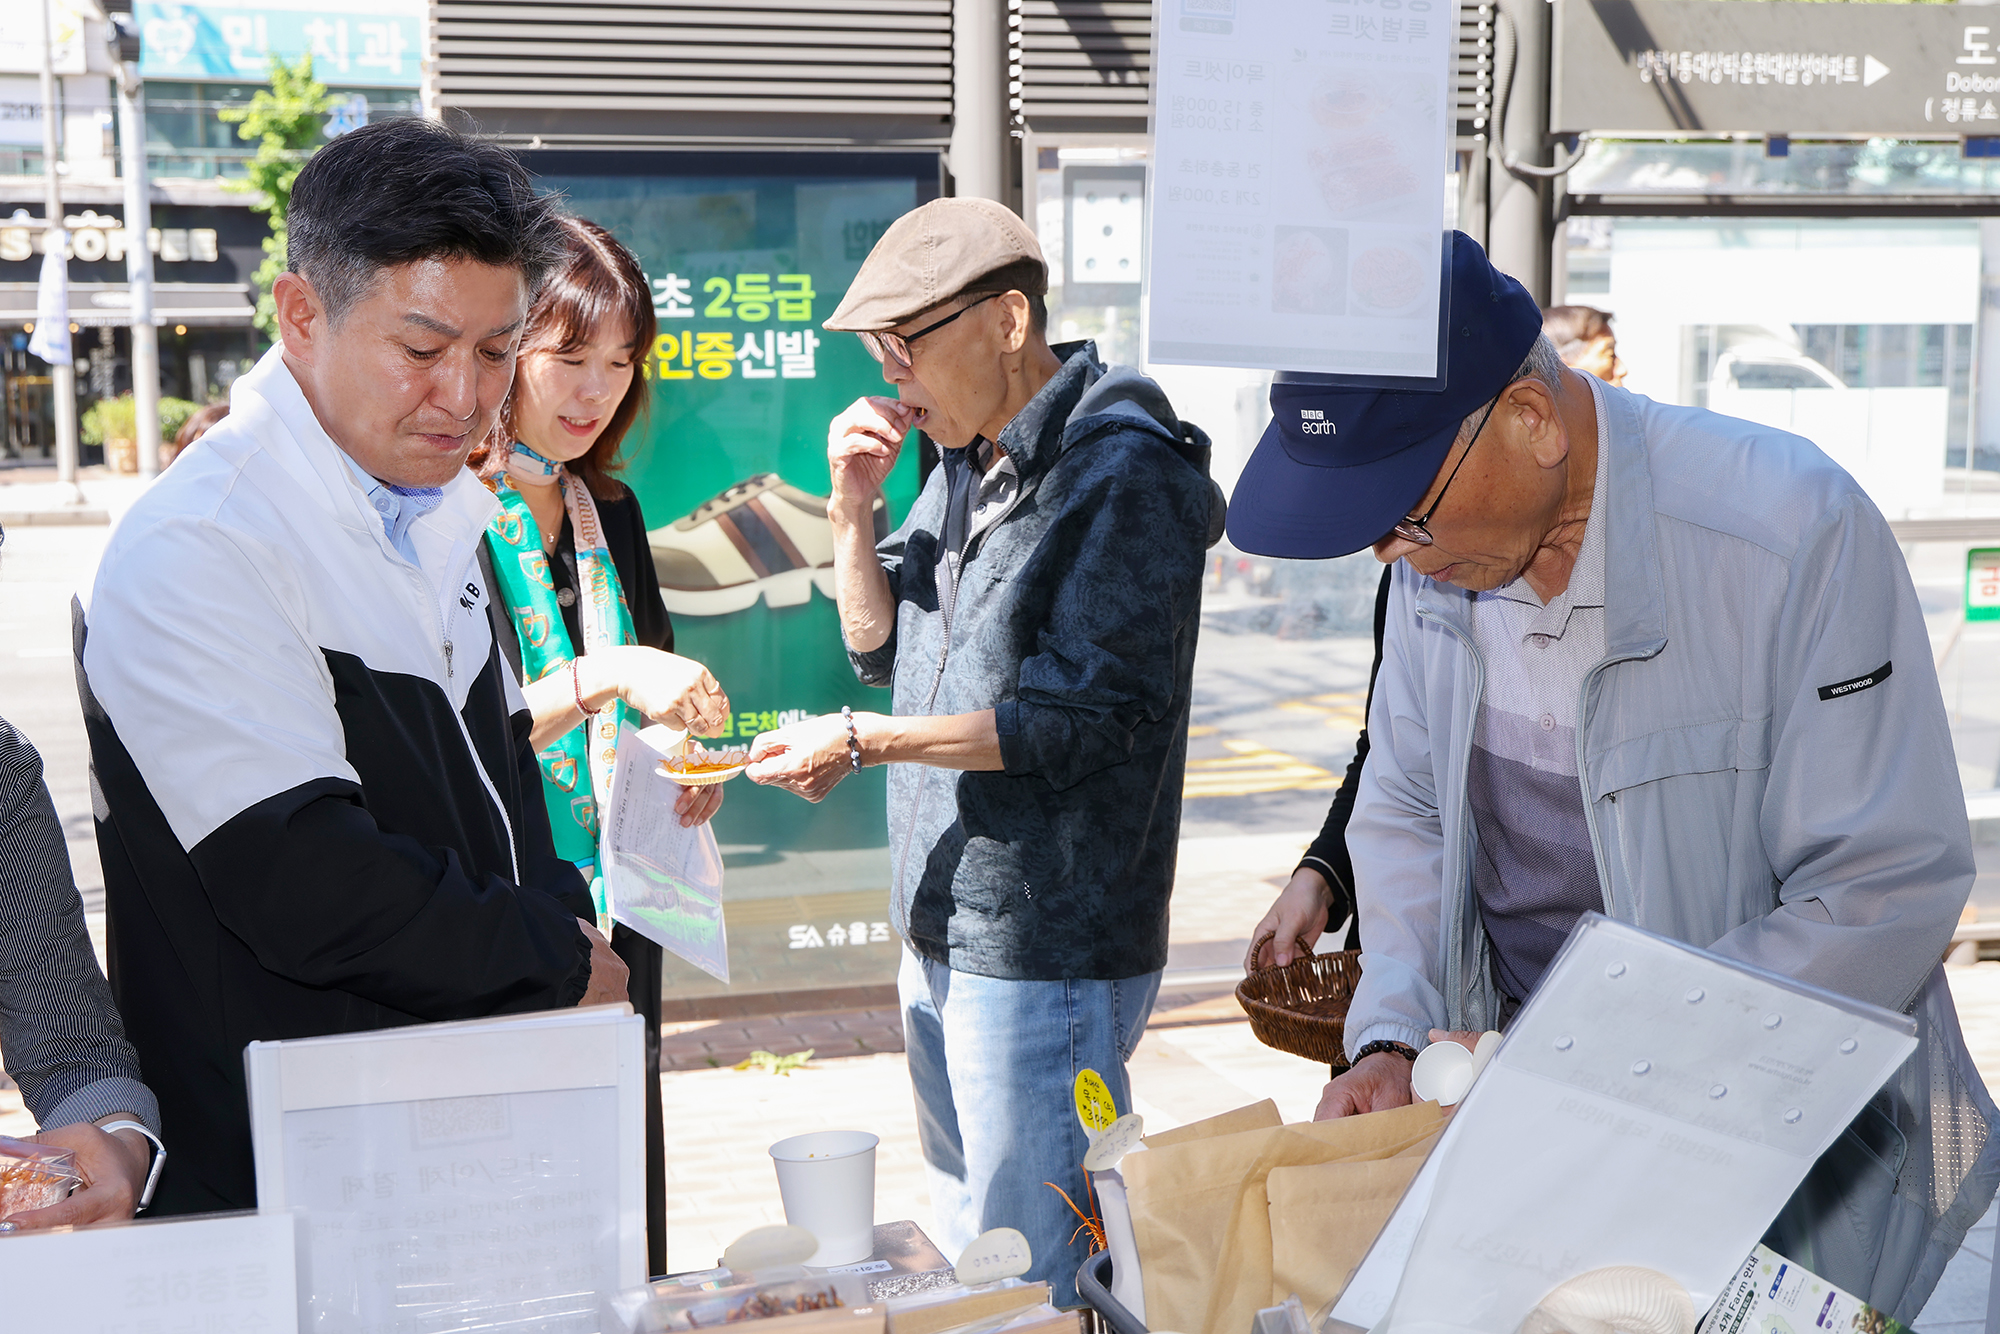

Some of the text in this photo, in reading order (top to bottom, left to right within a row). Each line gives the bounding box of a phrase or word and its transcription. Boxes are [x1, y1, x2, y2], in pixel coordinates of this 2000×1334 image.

[222, 15, 408, 75] 민 치과
[1955, 26, 2000, 65] 도
[703, 273, 816, 322] 2등급
[1301, 410, 1324, 420] BBC
[1302, 419, 1337, 435] earth
[1830, 677, 1873, 695] WESTWOOD
[788, 925, 825, 949] SA
[1718, 1256, 1759, 1333] 4개 Farm 안내
